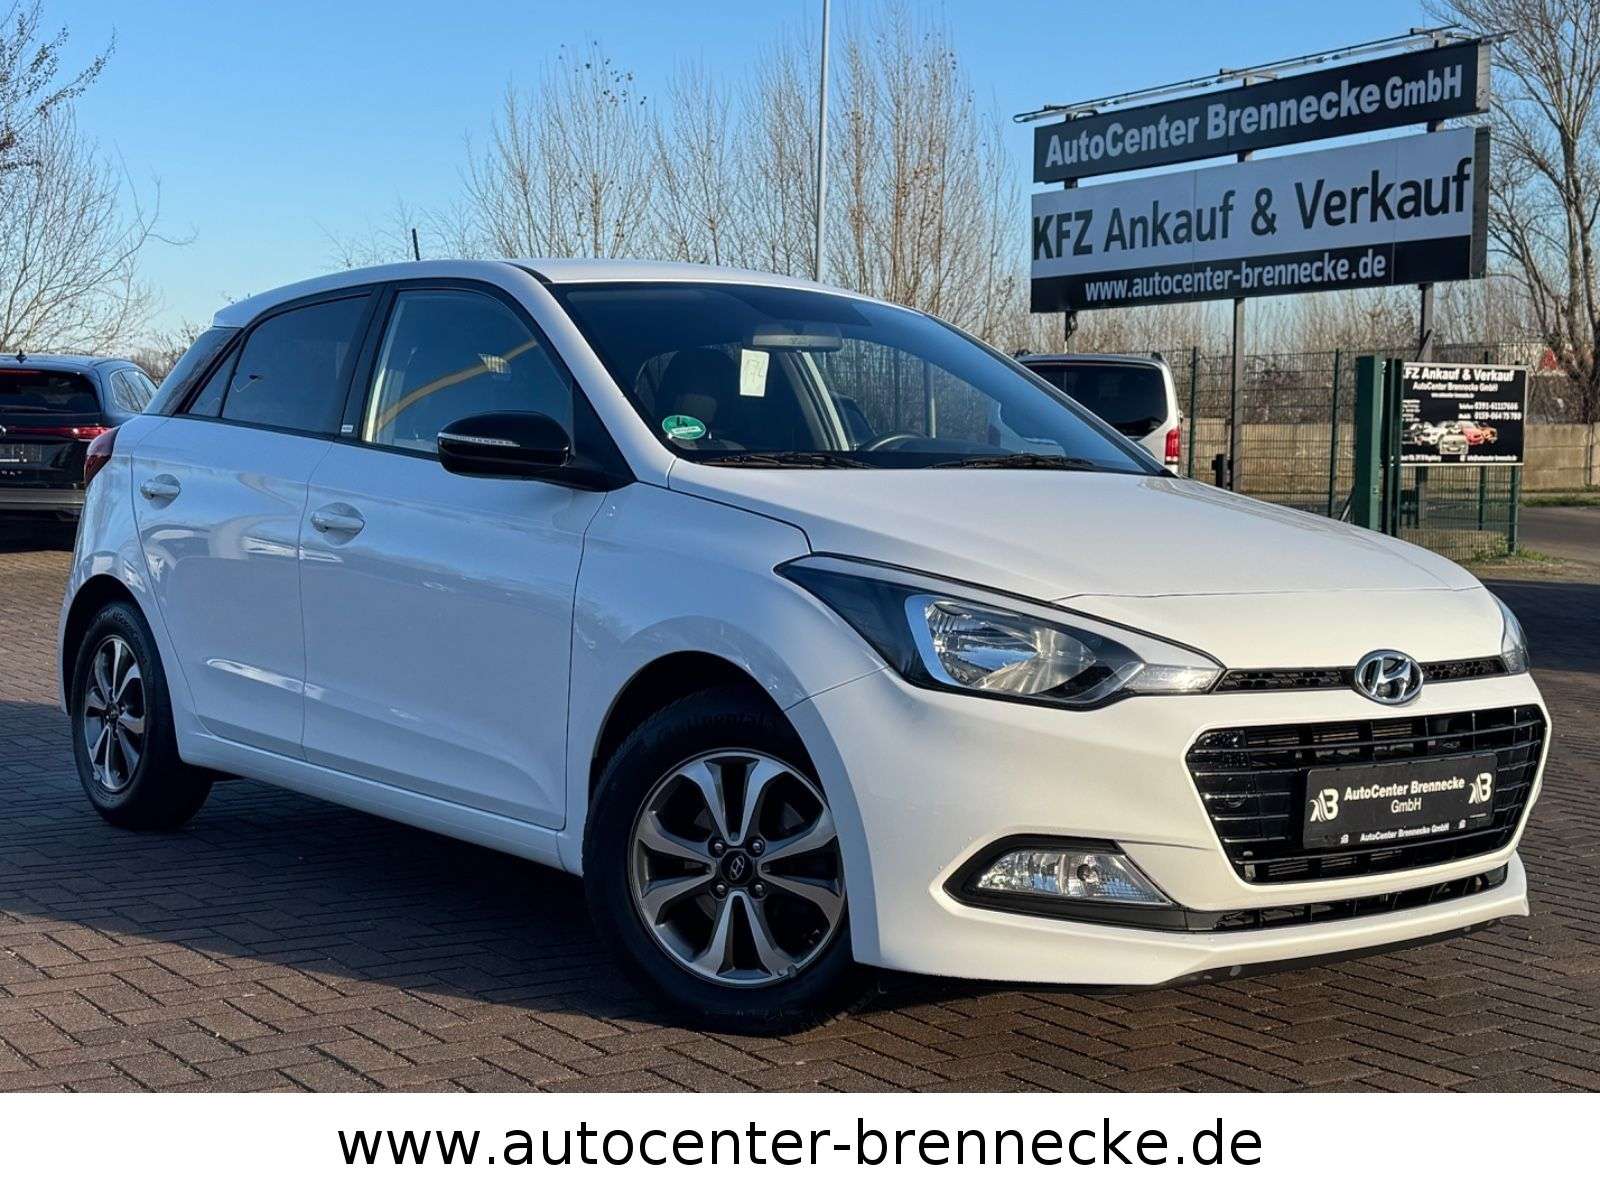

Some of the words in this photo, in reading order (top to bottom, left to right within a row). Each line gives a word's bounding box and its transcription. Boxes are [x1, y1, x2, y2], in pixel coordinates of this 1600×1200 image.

[1045, 114, 1200, 168] AutoCenter
[1206, 80, 1380, 141] Brennecke
[1384, 64, 1463, 110] GmbH
[1033, 209, 1094, 261] KFZ
[1104, 190, 1236, 252] Ankauf
[1250, 188, 1278, 237] &
[1294, 157, 1473, 229] Verkauf
[1085, 248, 1387, 302] www.autocenter-brennecke.de
[1422, 367, 1460, 381] Ankauf
[1462, 368, 1472, 381] &
[1474, 369, 1515, 382] Verkauf
[1344, 784, 1408, 802] AutoCenter
[1411, 776, 1465, 795] Brennecke
[1391, 798, 1422, 814] GmbH
[1360, 830, 1397, 842] AutoCenter
[1431, 822, 1450, 833] GmbH
